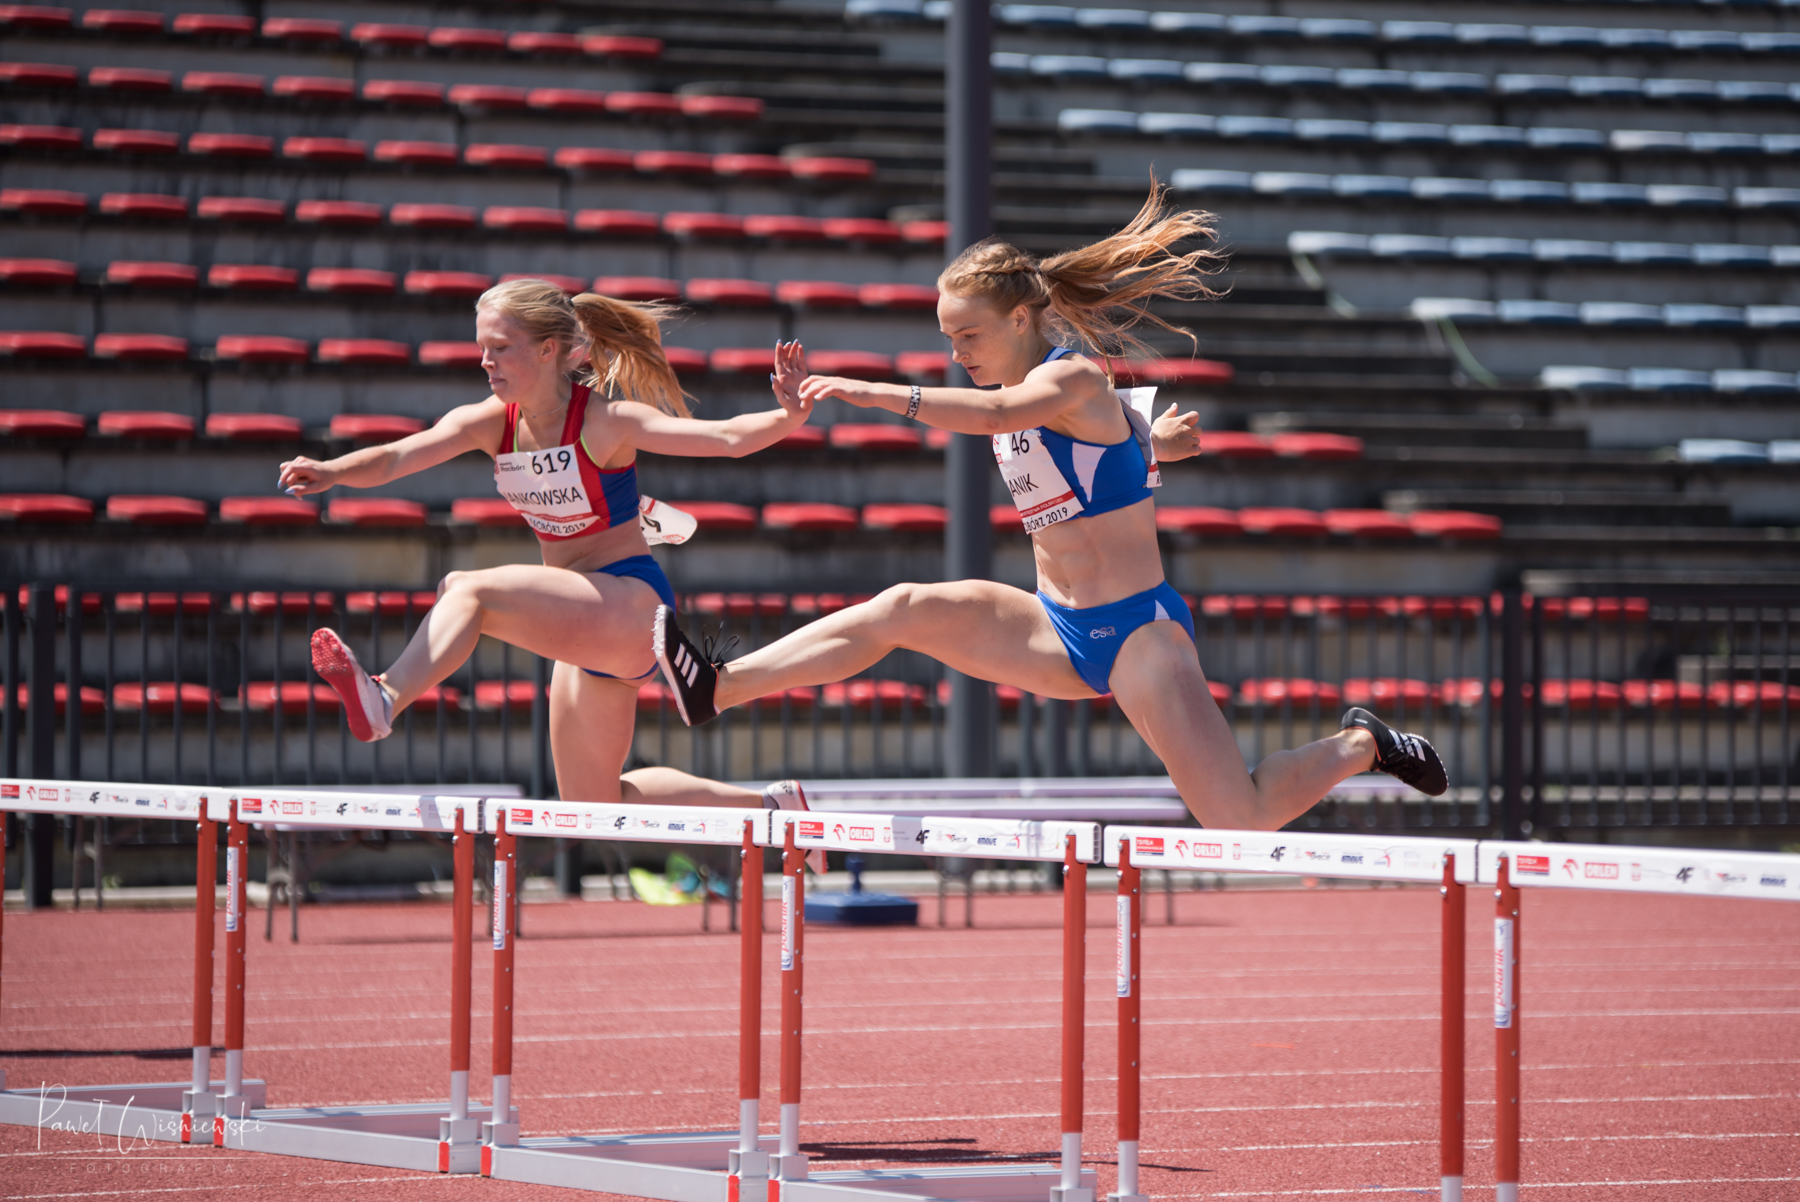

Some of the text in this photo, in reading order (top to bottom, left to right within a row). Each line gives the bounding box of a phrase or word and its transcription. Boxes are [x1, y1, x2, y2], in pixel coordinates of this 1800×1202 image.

[1011, 430, 1030, 456] 46
[531, 450, 571, 475] 619
[1005, 473, 1039, 497] ANIK
[1045, 507, 1068, 524] 2019
[563, 522, 586, 534] 2019
[89, 791, 100, 803] 4F
[283, 802, 302, 814] ORLEN
[336, 802, 348, 815] 4F
[556, 814, 577, 827] ORLEN
[614, 816, 626, 830] 4F
[850, 827, 873, 841] ORLEN
[915, 829, 930, 845] 4F
[1194, 843, 1222, 858] ORLEN
[1270, 846, 1286, 862] 4F
[1586, 863, 1618, 879] ORLEN
[1676, 866, 1695, 883] 4F
[1494, 948, 1505, 1007] polanik
